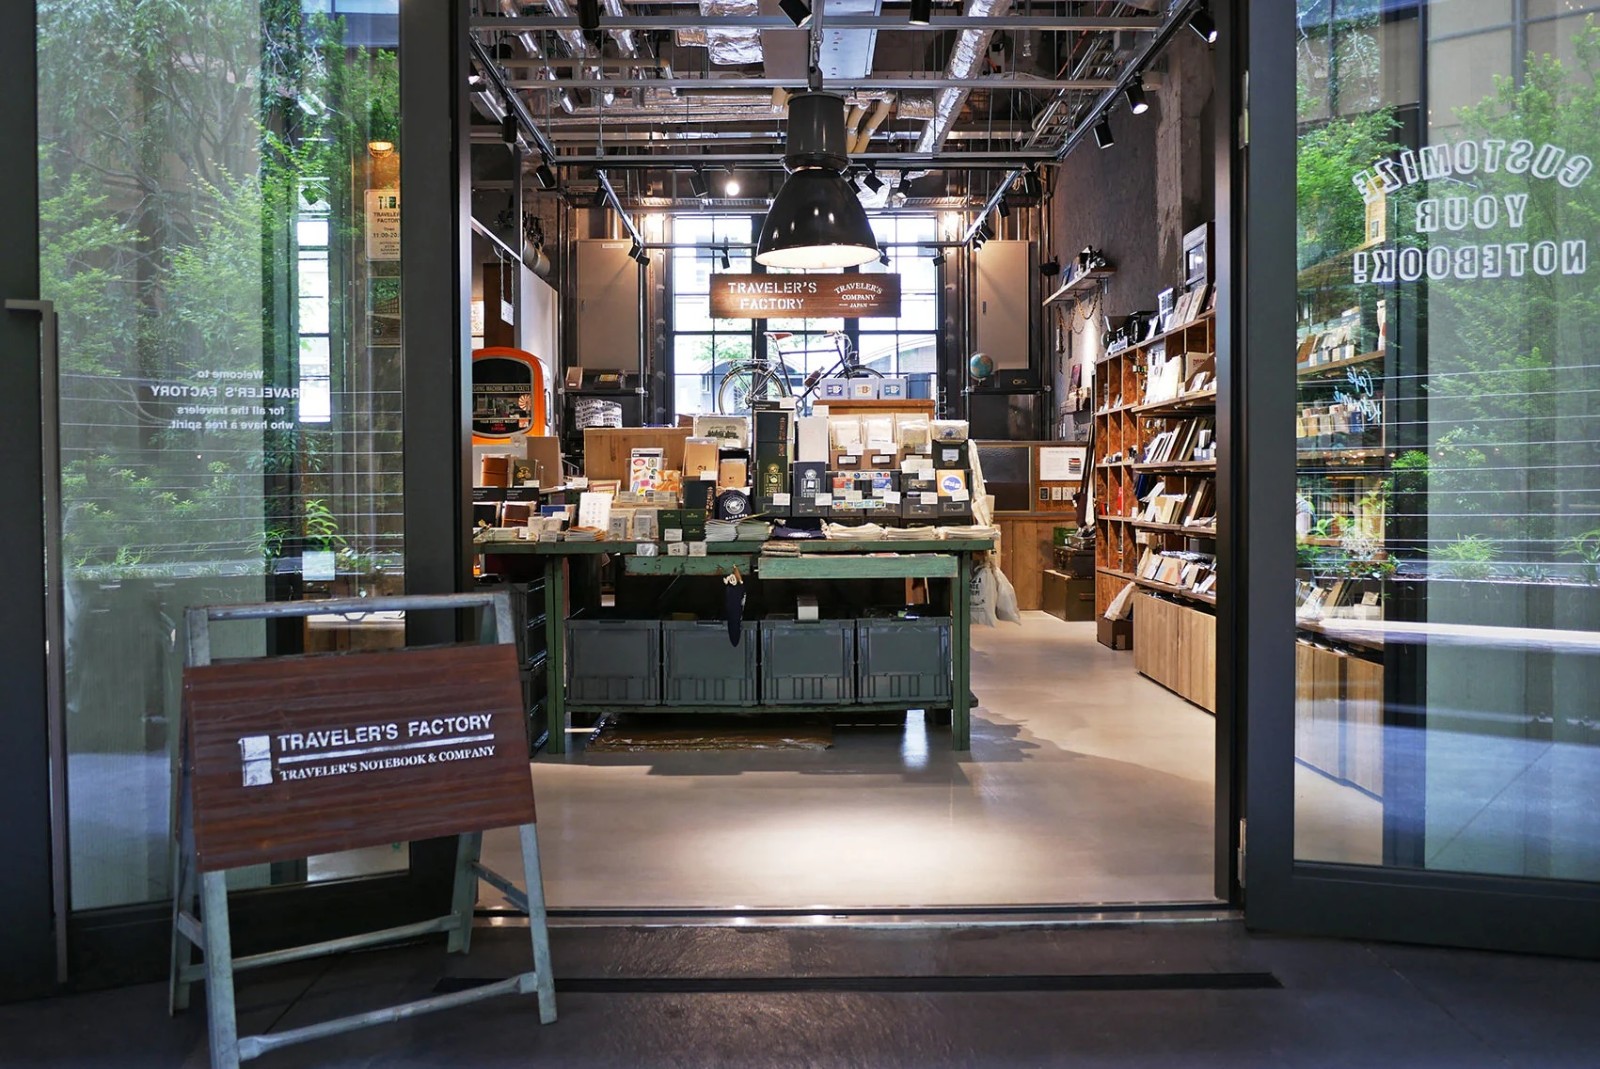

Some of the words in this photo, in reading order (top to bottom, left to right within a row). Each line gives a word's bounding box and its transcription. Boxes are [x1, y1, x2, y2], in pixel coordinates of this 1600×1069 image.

[727, 282, 818, 294] TRAVELER'S
[833, 282, 883, 295] TRAVELER'S
[841, 293, 876, 301] COMPANY
[740, 298, 805, 310] FACTORY
[277, 722, 399, 752] TRAVELER'S
[407, 713, 493, 738] FACTORY
[279, 762, 358, 781] TRAVELER'S
[359, 754, 426, 773] NOTEBOOK
[427, 753, 437, 763] &
[438, 745, 496, 762] COMPANY
